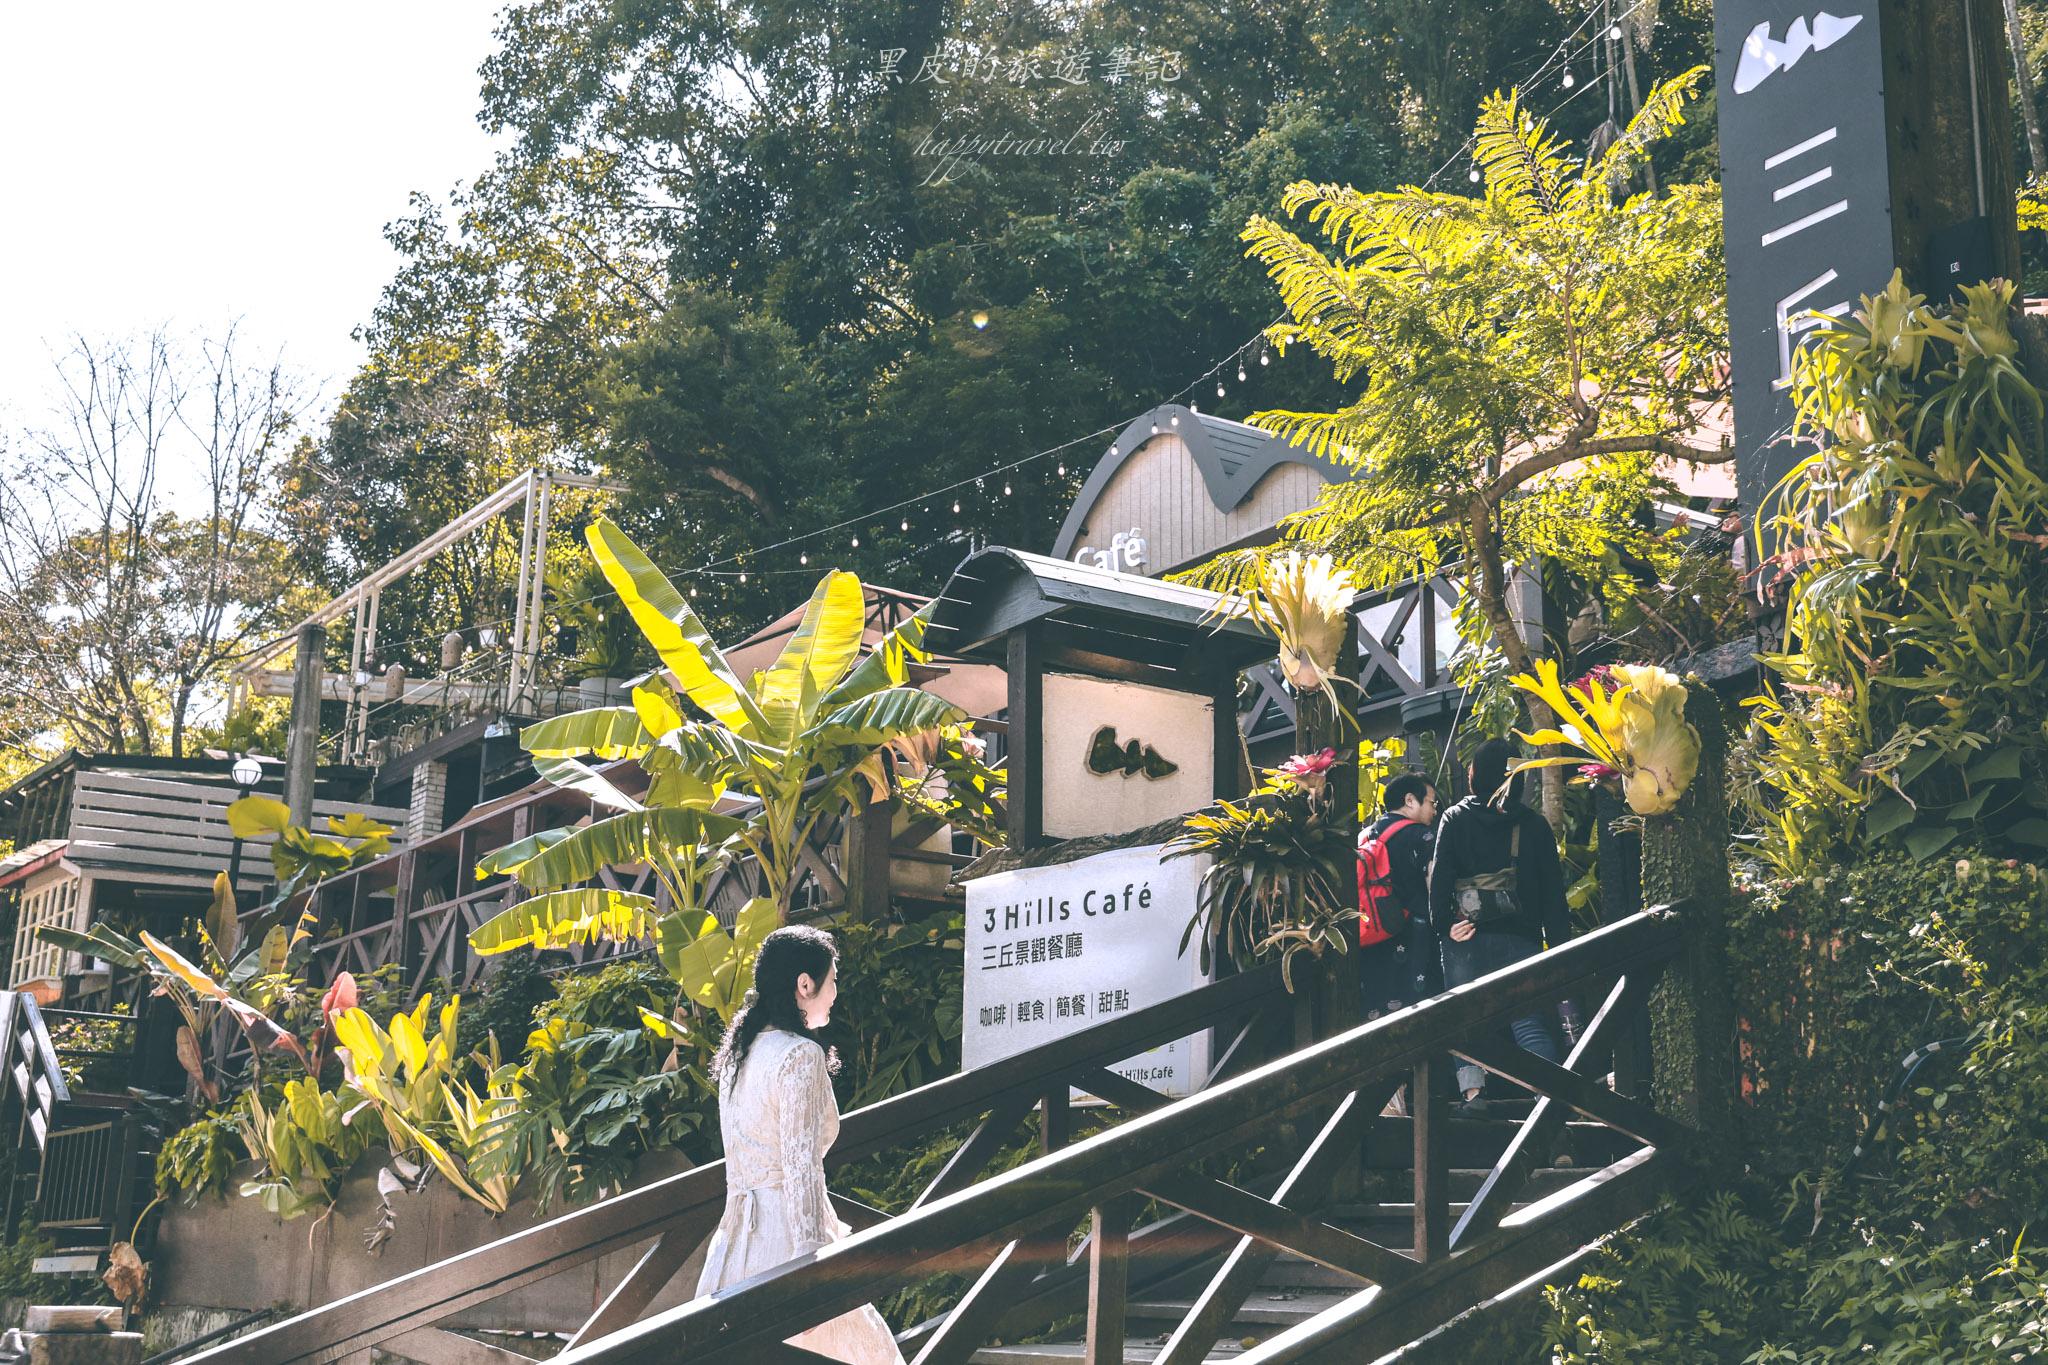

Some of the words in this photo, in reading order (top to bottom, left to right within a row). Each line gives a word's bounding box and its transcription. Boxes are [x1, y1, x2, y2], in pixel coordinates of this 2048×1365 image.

[984, 908, 996, 933] 3
[1083, 882, 1152, 917] Café
[982, 932, 1083, 971] 三丘景觀餐廳
[979, 1004, 1007, 1027] 咖啡
[1017, 999, 1046, 1023] 輕食
[1056, 994, 1086, 1018] 簡餐
[1098, 989, 1129, 1014] 甜點
[1151, 1066, 1173, 1079] Café
